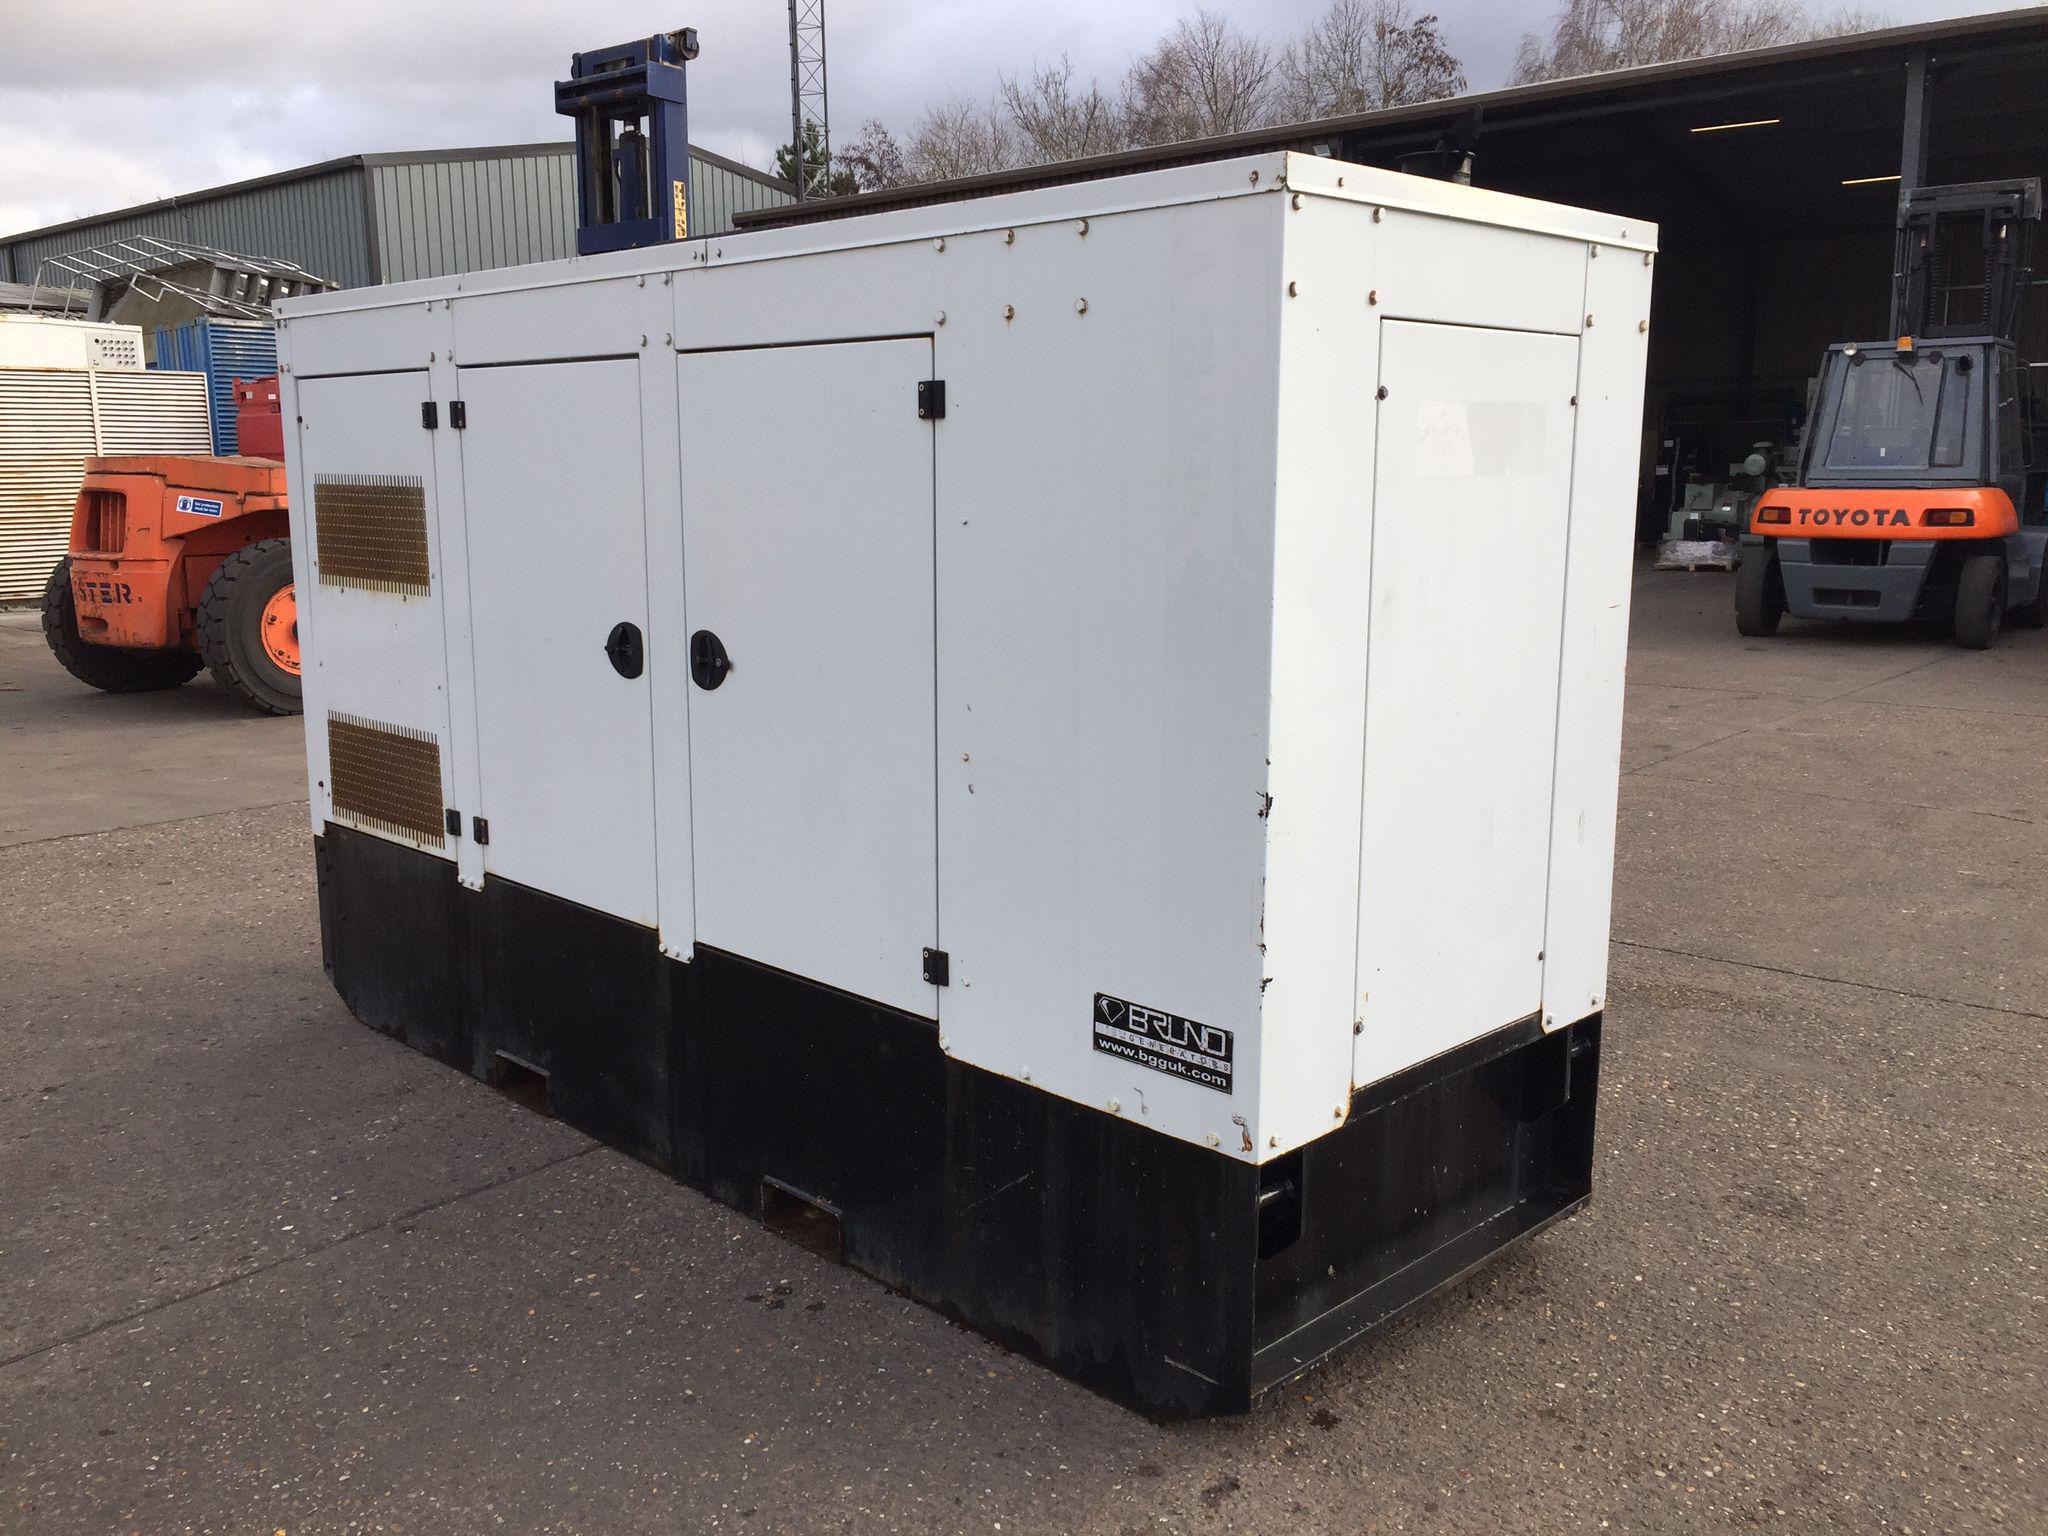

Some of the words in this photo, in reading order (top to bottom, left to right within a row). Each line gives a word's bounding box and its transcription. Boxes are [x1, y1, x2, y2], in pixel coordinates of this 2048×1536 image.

[1798, 508, 1911, 526] TOYOTA
[1129, 1004, 1226, 1057] BRUNO
[1098, 1038, 1227, 1087] www.bgguk.com
